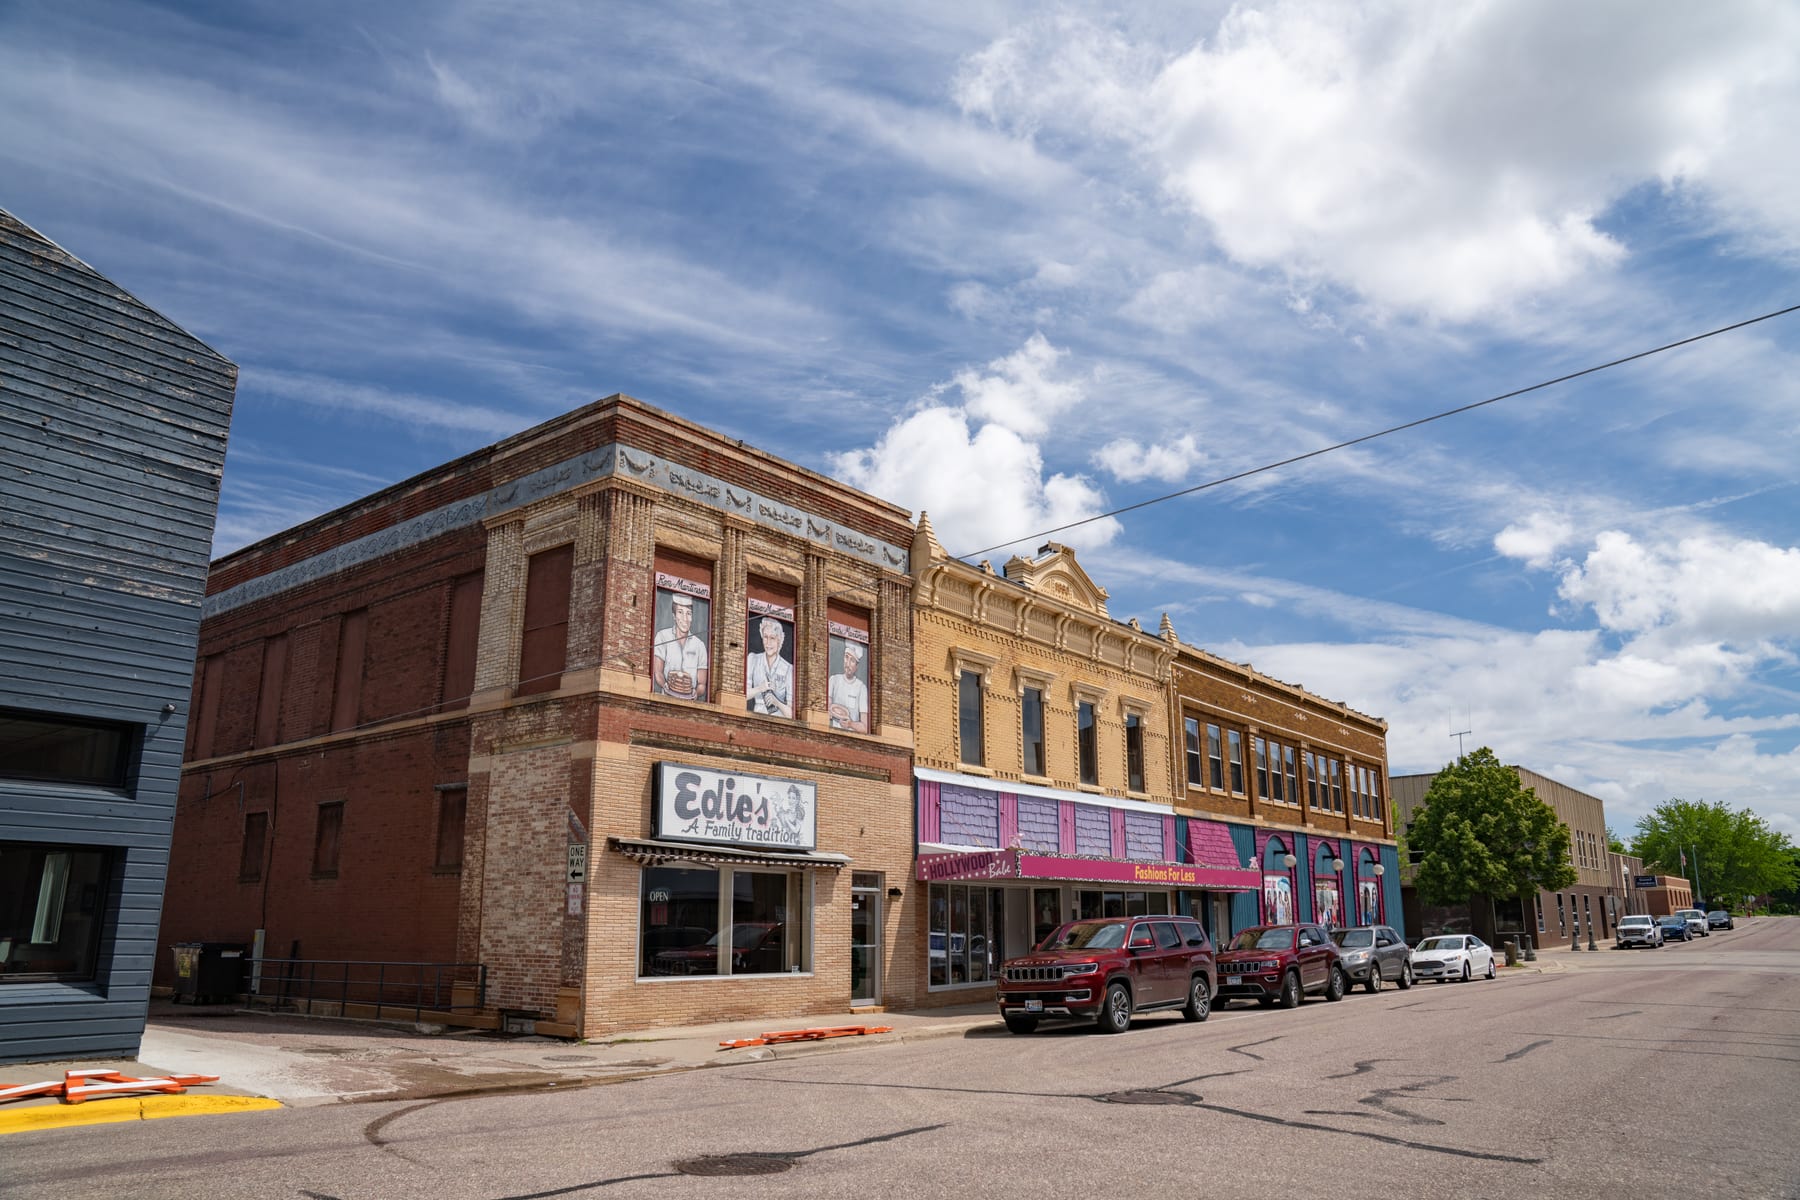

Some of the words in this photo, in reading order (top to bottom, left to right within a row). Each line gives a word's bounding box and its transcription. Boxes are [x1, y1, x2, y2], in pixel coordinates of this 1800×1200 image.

[674, 772, 768, 825] Edie's
[681, 818, 699, 834] A
[704, 820, 741, 841] Family
[570, 846, 584, 857] ONE
[569, 857, 584, 868] WAY
[929, 852, 993, 879] HOLLYWOOD
[988, 860, 1011, 879] Babe
[1135, 865, 1168, 881] Fashions
[1168, 867, 1180, 881] For
[1180, 868, 1196, 882] Less
[649, 890, 669, 902] OPEN
